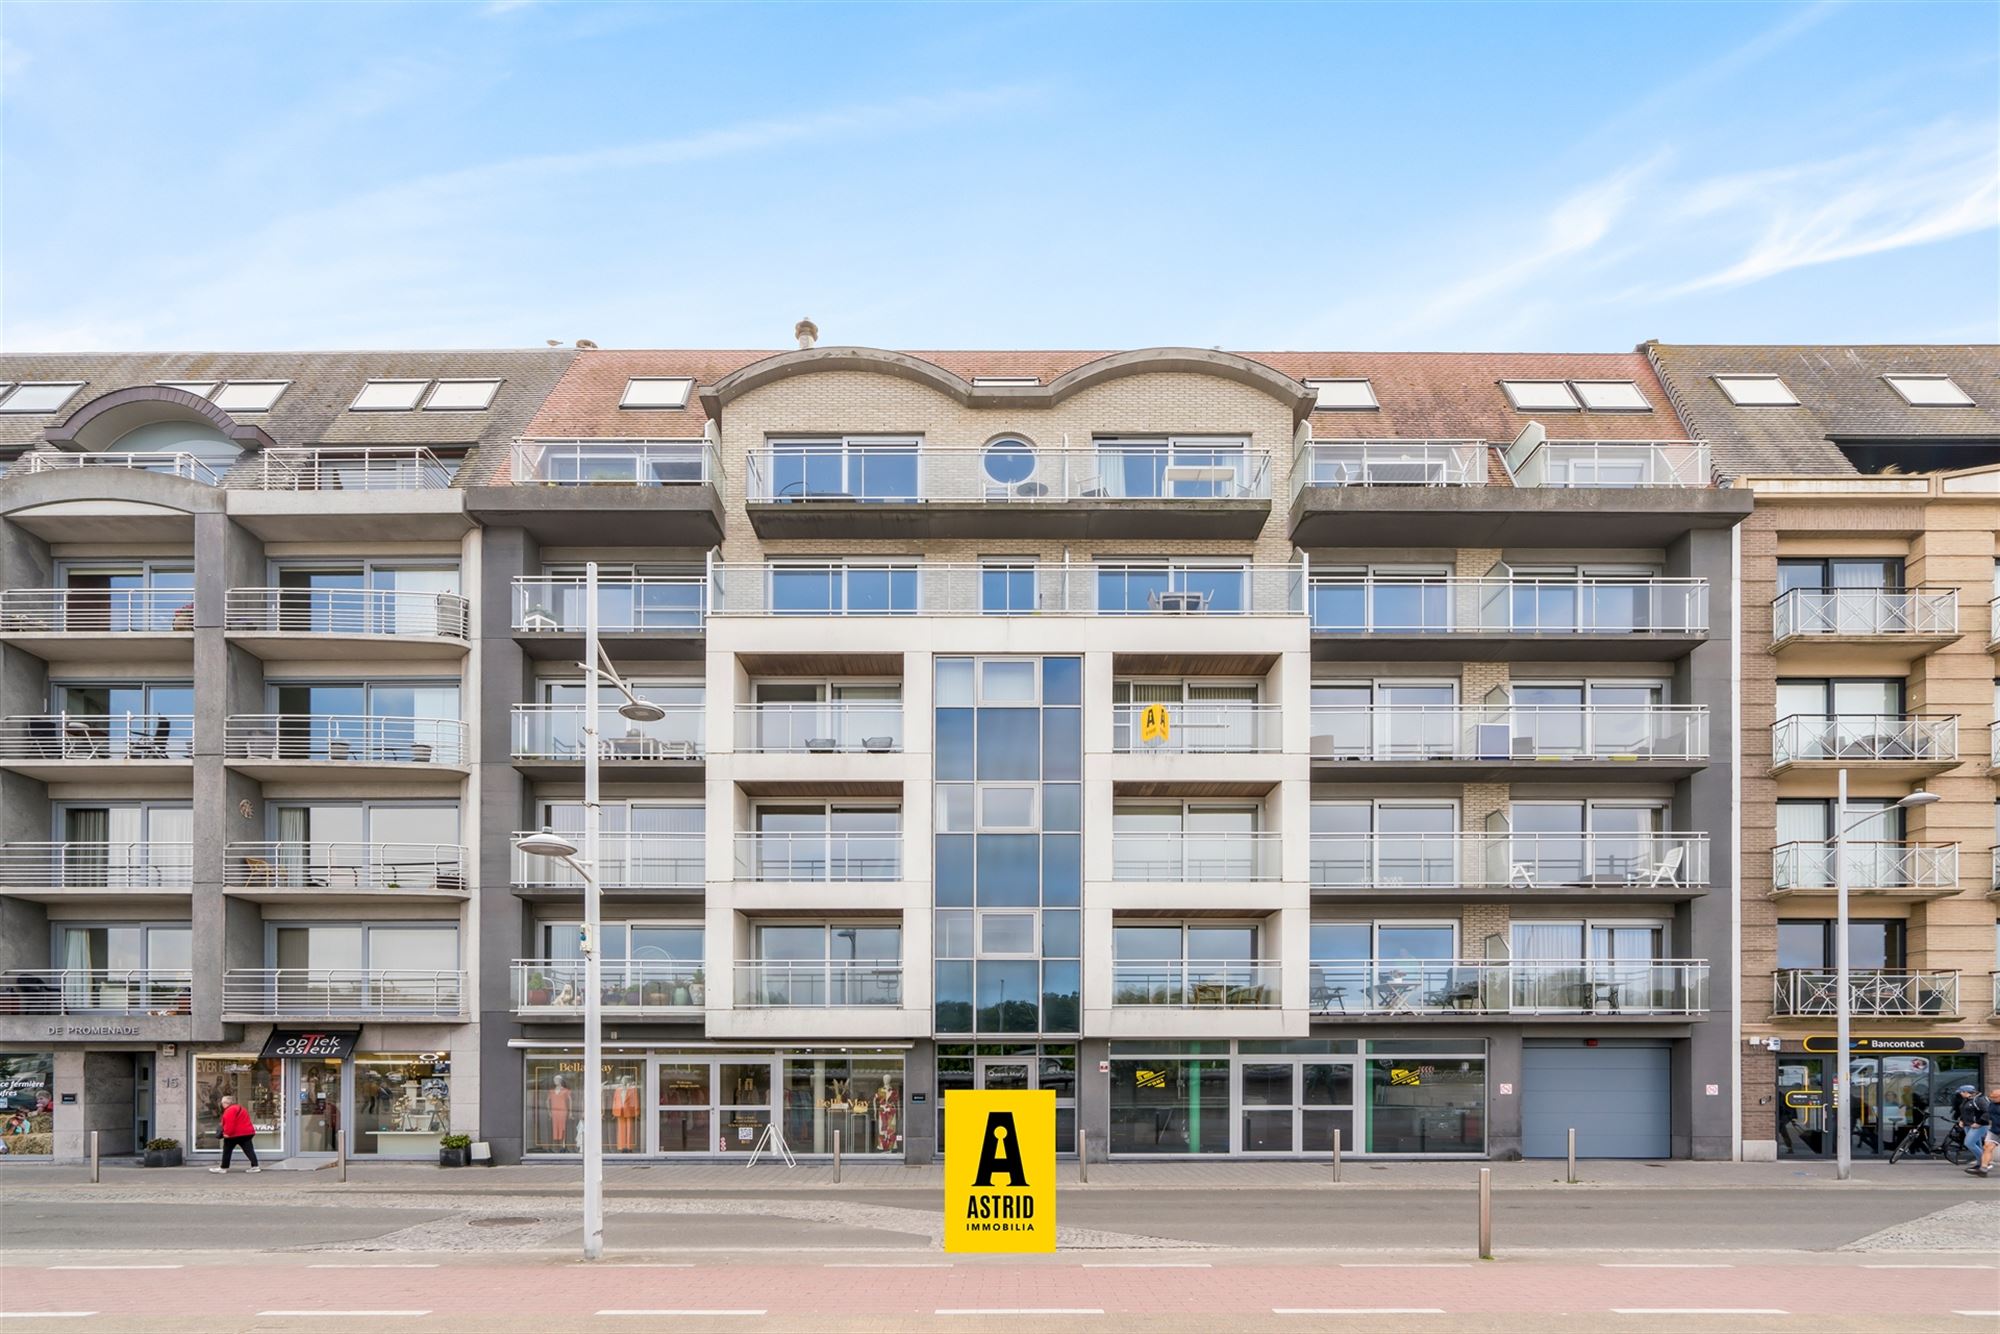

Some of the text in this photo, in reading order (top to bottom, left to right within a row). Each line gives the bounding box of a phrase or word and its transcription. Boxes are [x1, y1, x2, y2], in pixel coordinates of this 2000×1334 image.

[1146, 708, 1155, 728] A
[47, 1026, 140, 1036] DE PROMENADE
[1871, 1040, 1925, 1048] Bancontact
